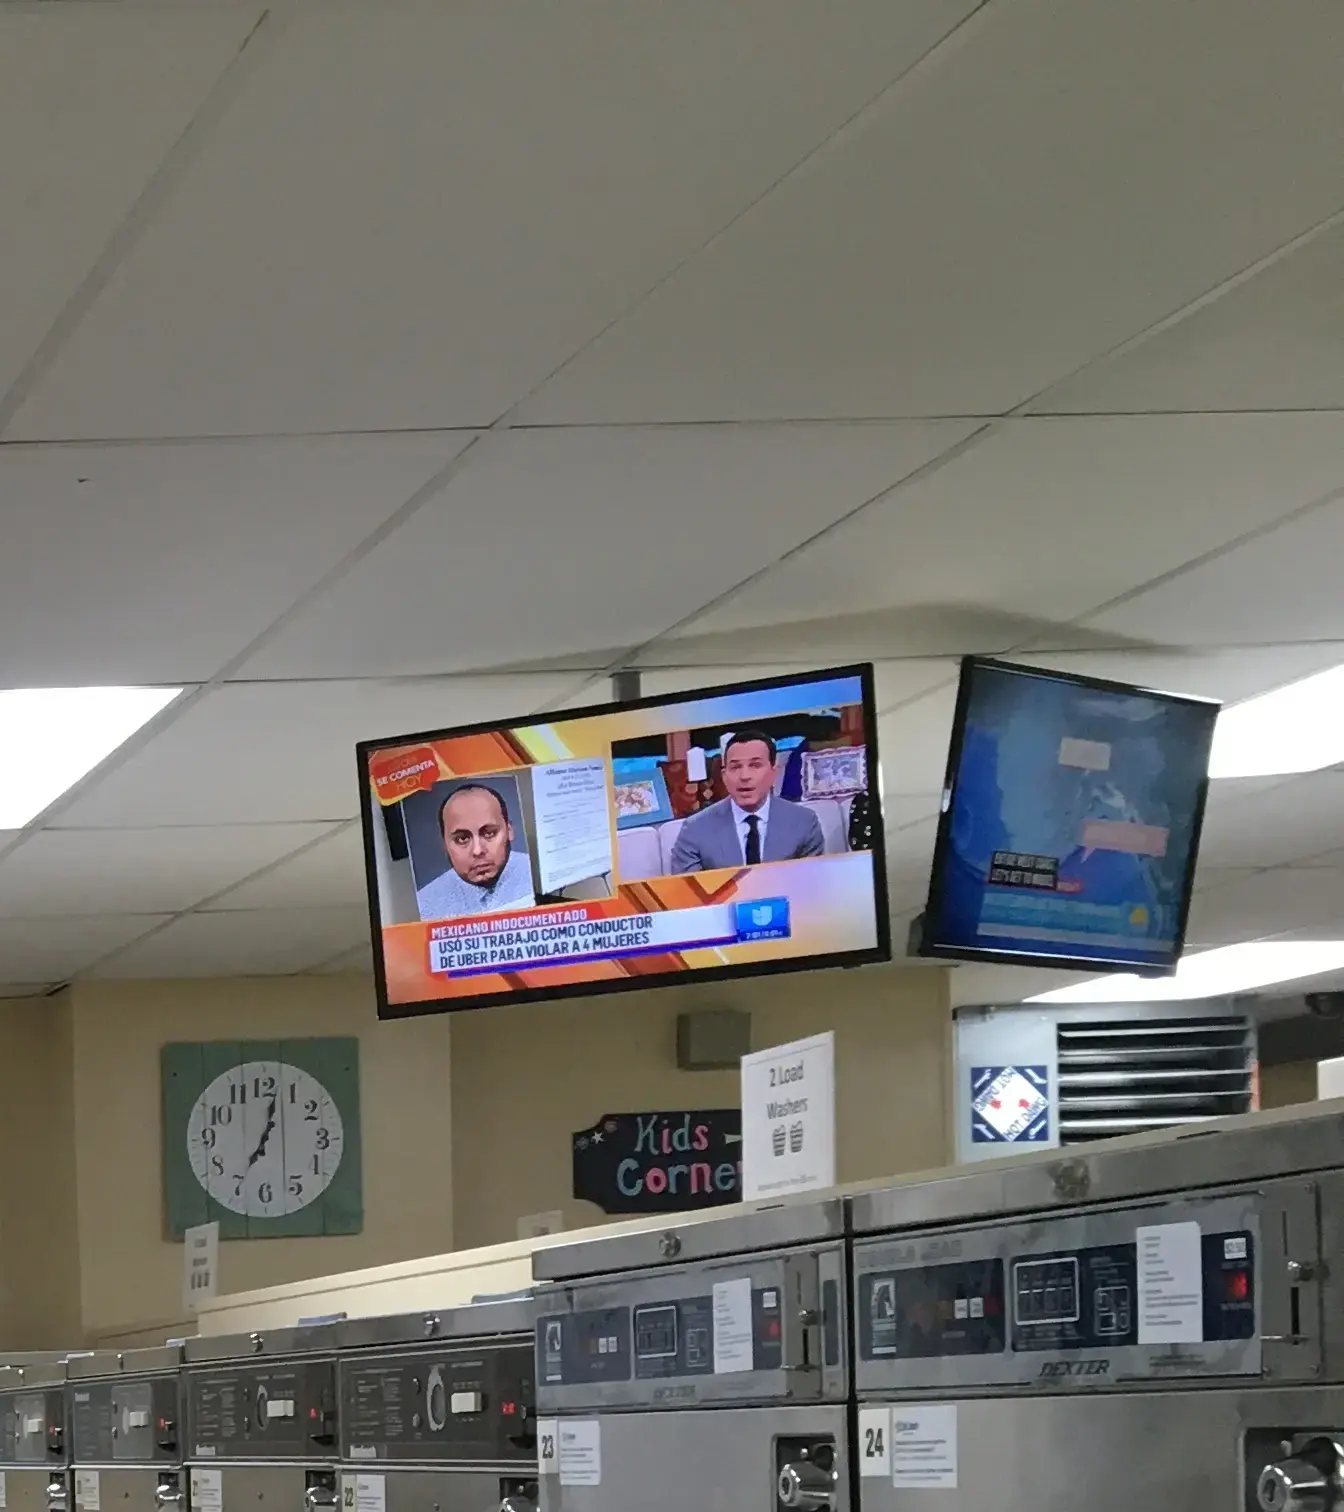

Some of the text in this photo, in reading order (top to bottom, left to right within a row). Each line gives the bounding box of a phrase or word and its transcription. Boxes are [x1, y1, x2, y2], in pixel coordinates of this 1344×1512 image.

[390, 759, 435, 783] COMENTA
[431, 908, 588, 939] MEXICANO INDOCUMENTADO
[438, 915, 653, 955] USÓ SU TRABAJO COMO CONDUCTOR
[440, 931, 650, 970] DE UBER PARA VIOLAR A 4 MUJERES
[769, 1060, 804, 1088] 2 Load
[230, 1083, 247, 1104] 11
[254, 1076, 277, 1098] 12
[289, 1082, 296, 1104] 1
[210, 1104, 232, 1126] 10
[304, 1099, 319, 1121] 2
[766, 1096, 808, 1120] Washers
[201, 1127, 216, 1150] 9
[316, 1127, 330, 1150] 3
[635, 1112, 710, 1156] Kids
[212, 1155, 224, 1176] 8
[309, 1154, 319, 1175] 4
[232, 1174, 244, 1196] 7
[288, 1174, 303, 1196] 5
[616, 1157, 743, 1198] Corne
[258, 1182, 273, 1204] 6
[1039, 1359, 1110, 1377] DEXTER
[541, 1434, 554, 1459] 23
[865, 1428, 884, 1457] 24
